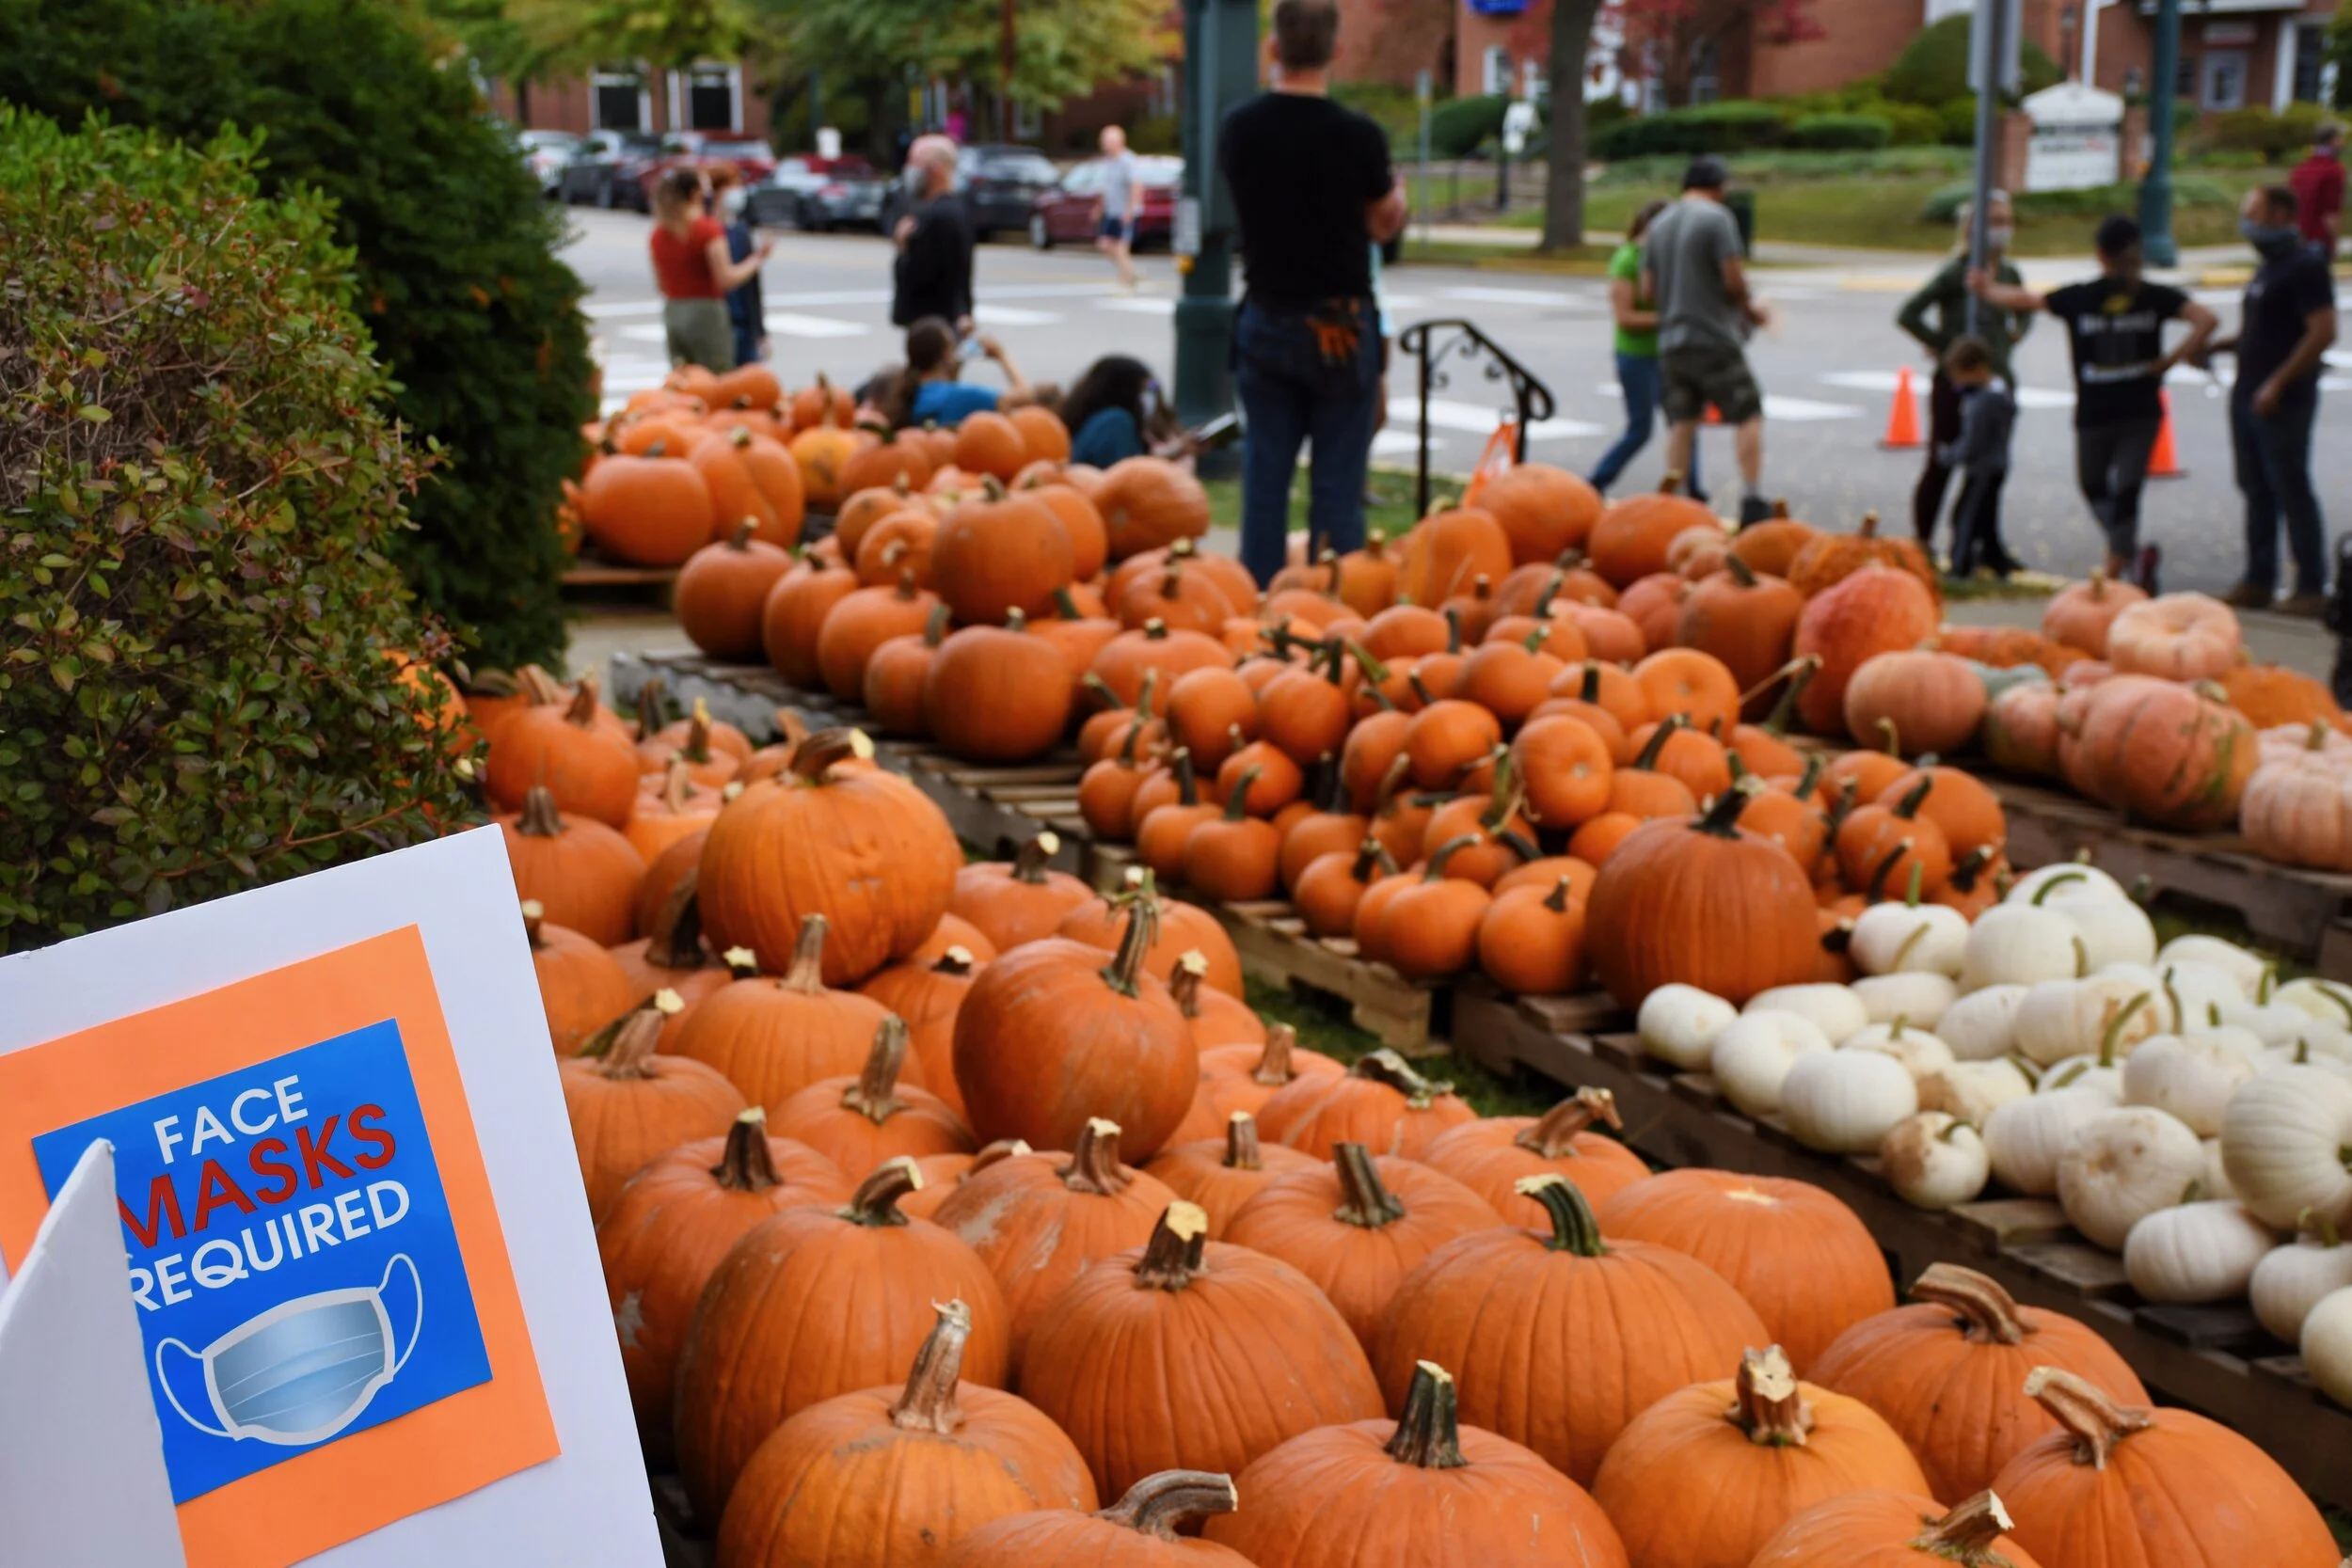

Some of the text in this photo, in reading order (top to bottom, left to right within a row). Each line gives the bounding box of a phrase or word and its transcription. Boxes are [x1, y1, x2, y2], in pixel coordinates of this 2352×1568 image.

[117, 1103, 396, 1249] MASKS
[153, 1075, 309, 1164] FACE
[129, 1180, 410, 1312] REQUIRED
